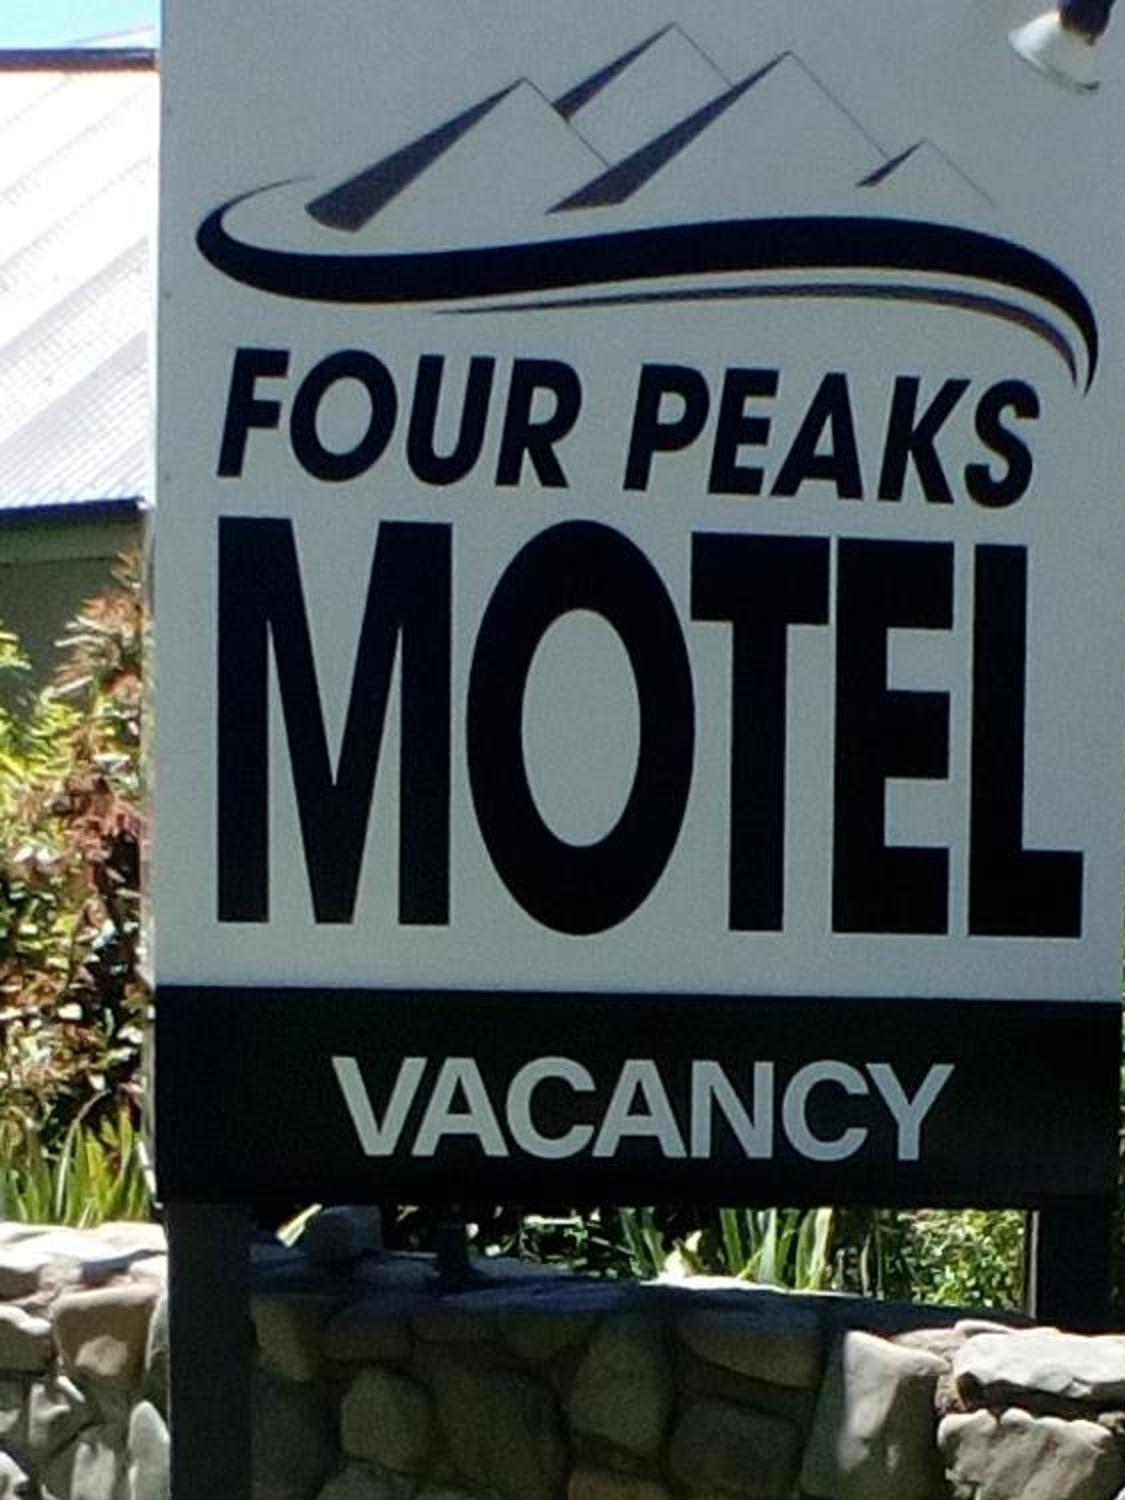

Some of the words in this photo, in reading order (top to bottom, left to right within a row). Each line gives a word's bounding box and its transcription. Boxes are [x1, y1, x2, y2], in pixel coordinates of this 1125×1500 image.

[215, 345, 583, 490] FOUR
[621, 362, 1041, 510] PEAKS
[215, 514, 1086, 941] MOTEL
[332, 1056, 955, 1163] VACANCY
